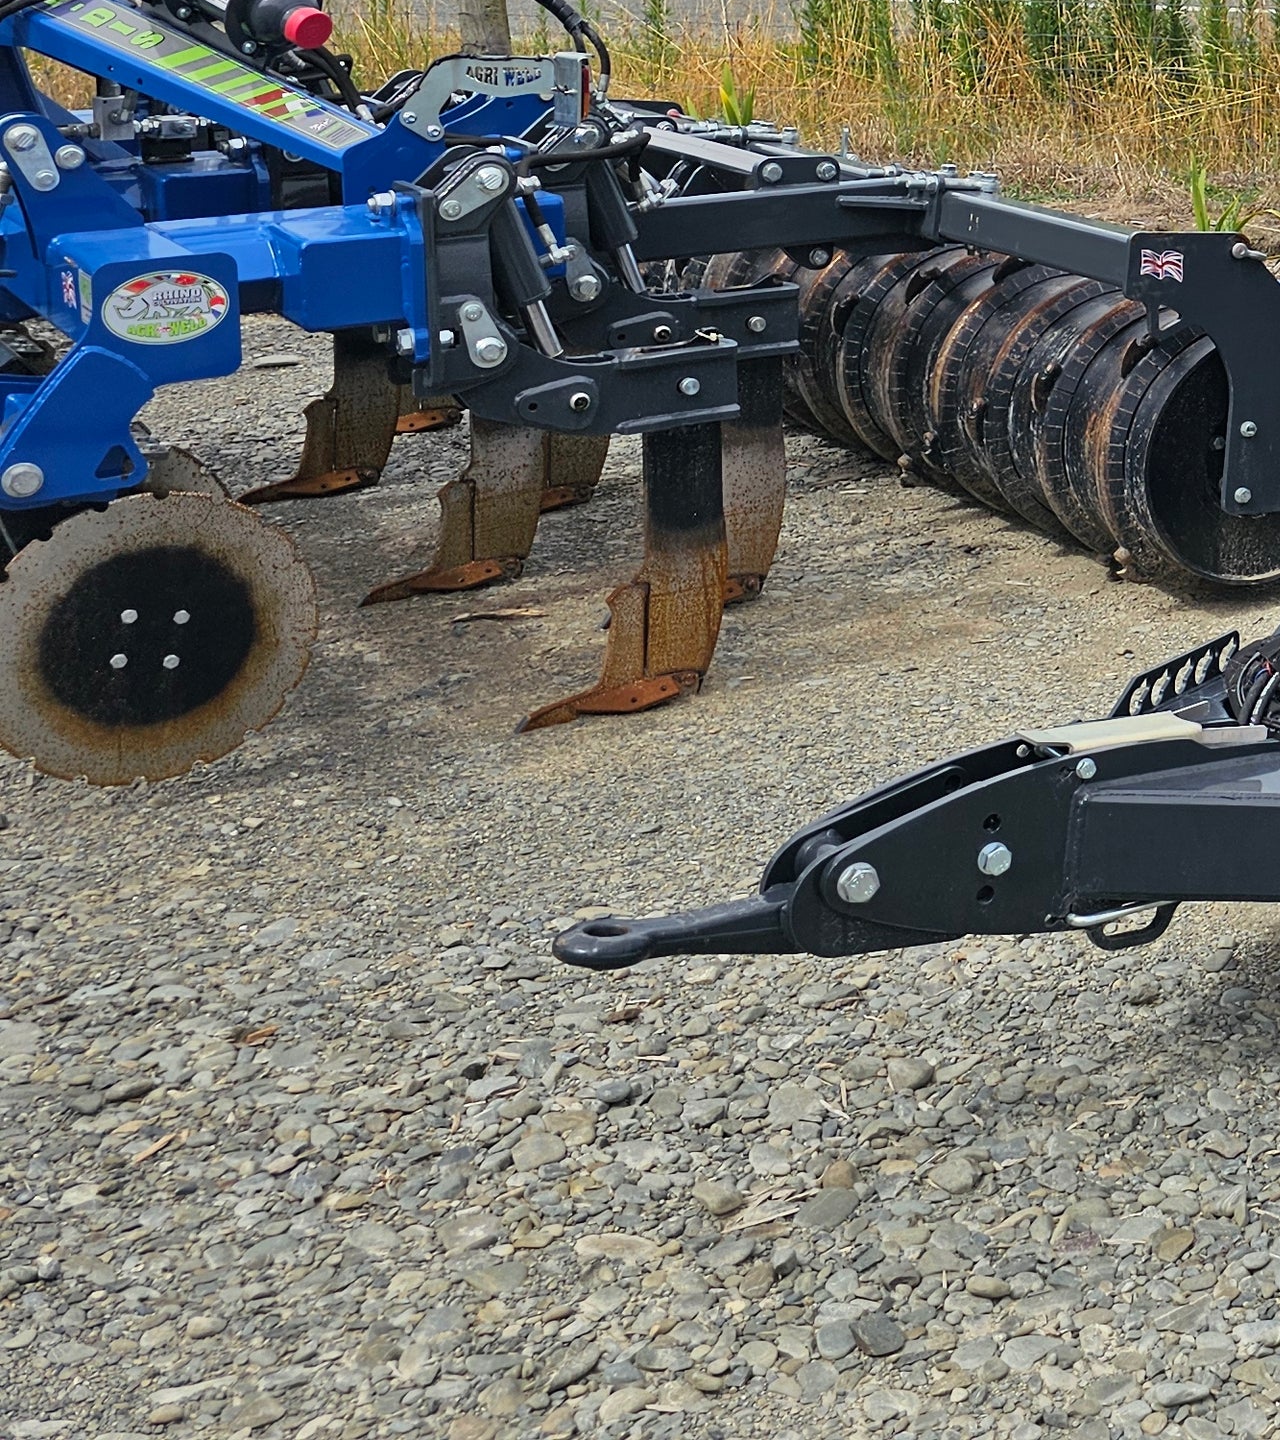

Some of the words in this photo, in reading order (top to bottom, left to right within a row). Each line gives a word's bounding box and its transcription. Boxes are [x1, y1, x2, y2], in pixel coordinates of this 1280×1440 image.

[465, 66, 498, 86] AGRI
[503, 67, 542, 87] WELD
[154, 289, 202, 299] RHINO
